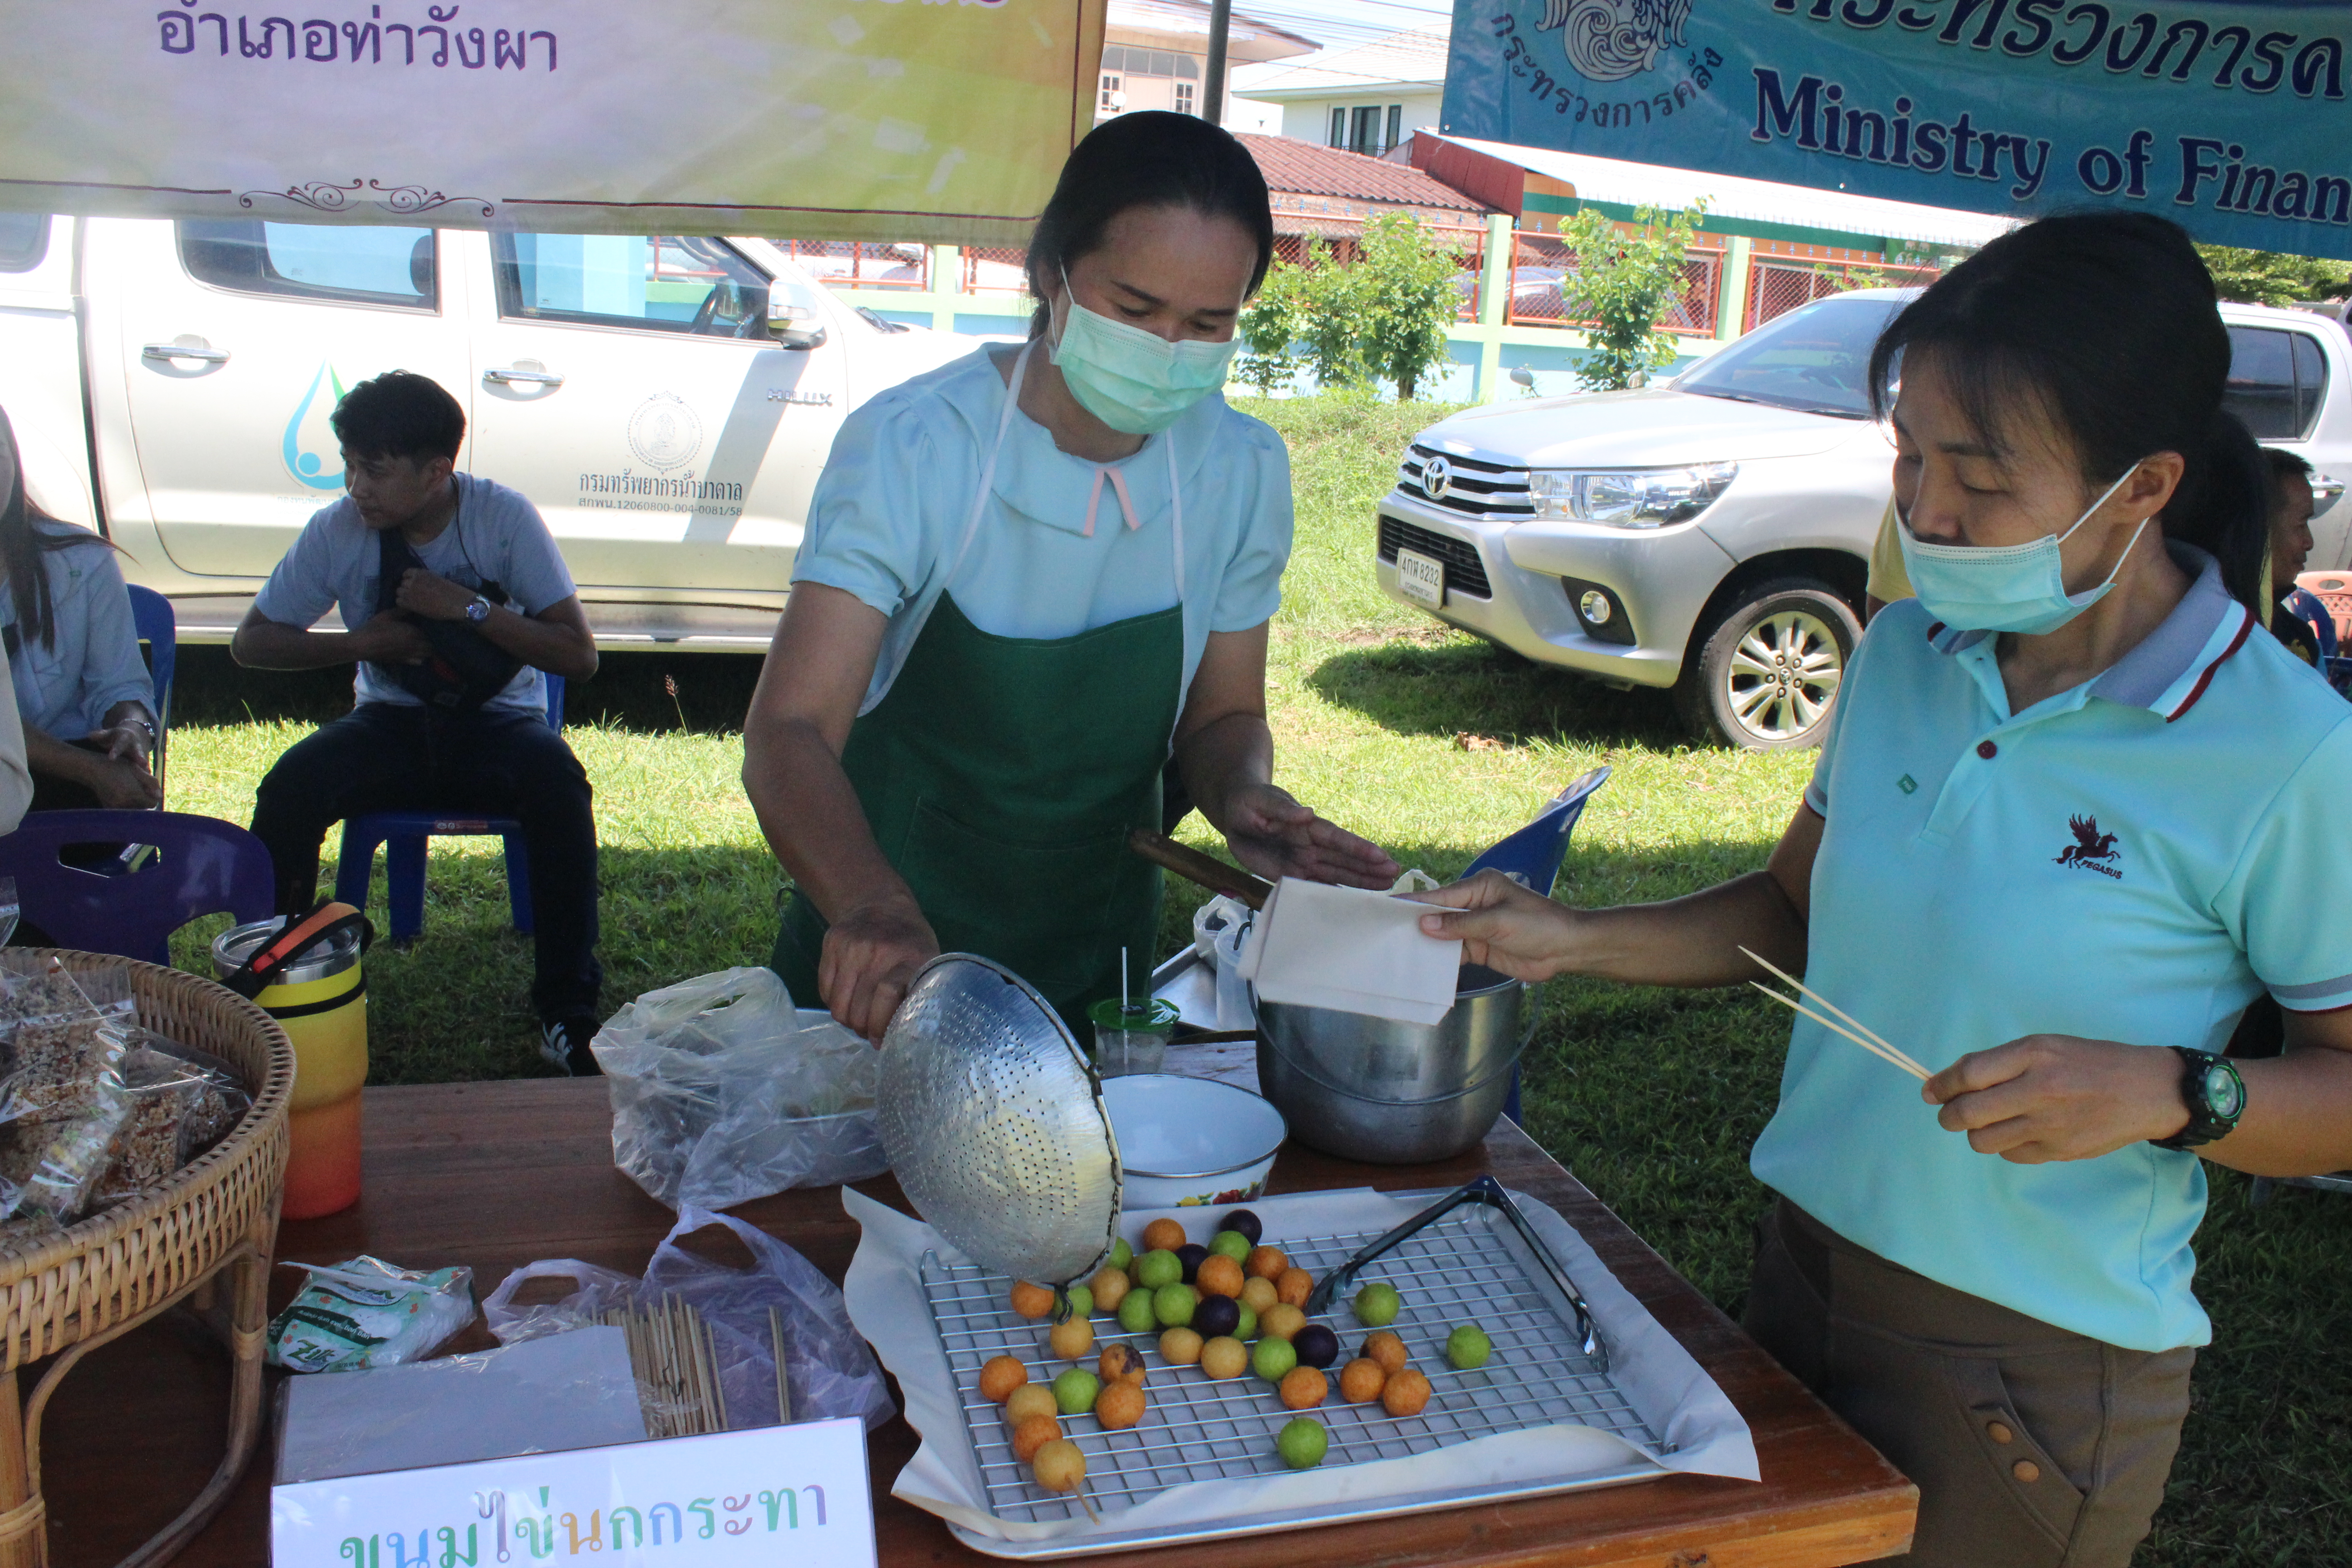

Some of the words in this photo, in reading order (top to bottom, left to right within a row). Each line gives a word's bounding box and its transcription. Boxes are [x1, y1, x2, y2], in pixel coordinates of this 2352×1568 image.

[157, 0, 558, 72] อำเภอท่าวังผา
[1491, 13, 1723, 128] กระทรวงการคลัง
[1752, 67, 2052, 200] Ministry
[2078, 130, 2153, 199] of
[2176, 137, 2351, 225] Finan
[768, 389, 832, 407] HILUX
[580, 468, 742, 501] กรมทรัพยากรน้ำบาดาล
[1420, 563, 1439, 587] 8232
[2081, 860, 2122, 879] PEGASUS
[340, 1484, 828, 1568] ขนมไข่นกกระทา
